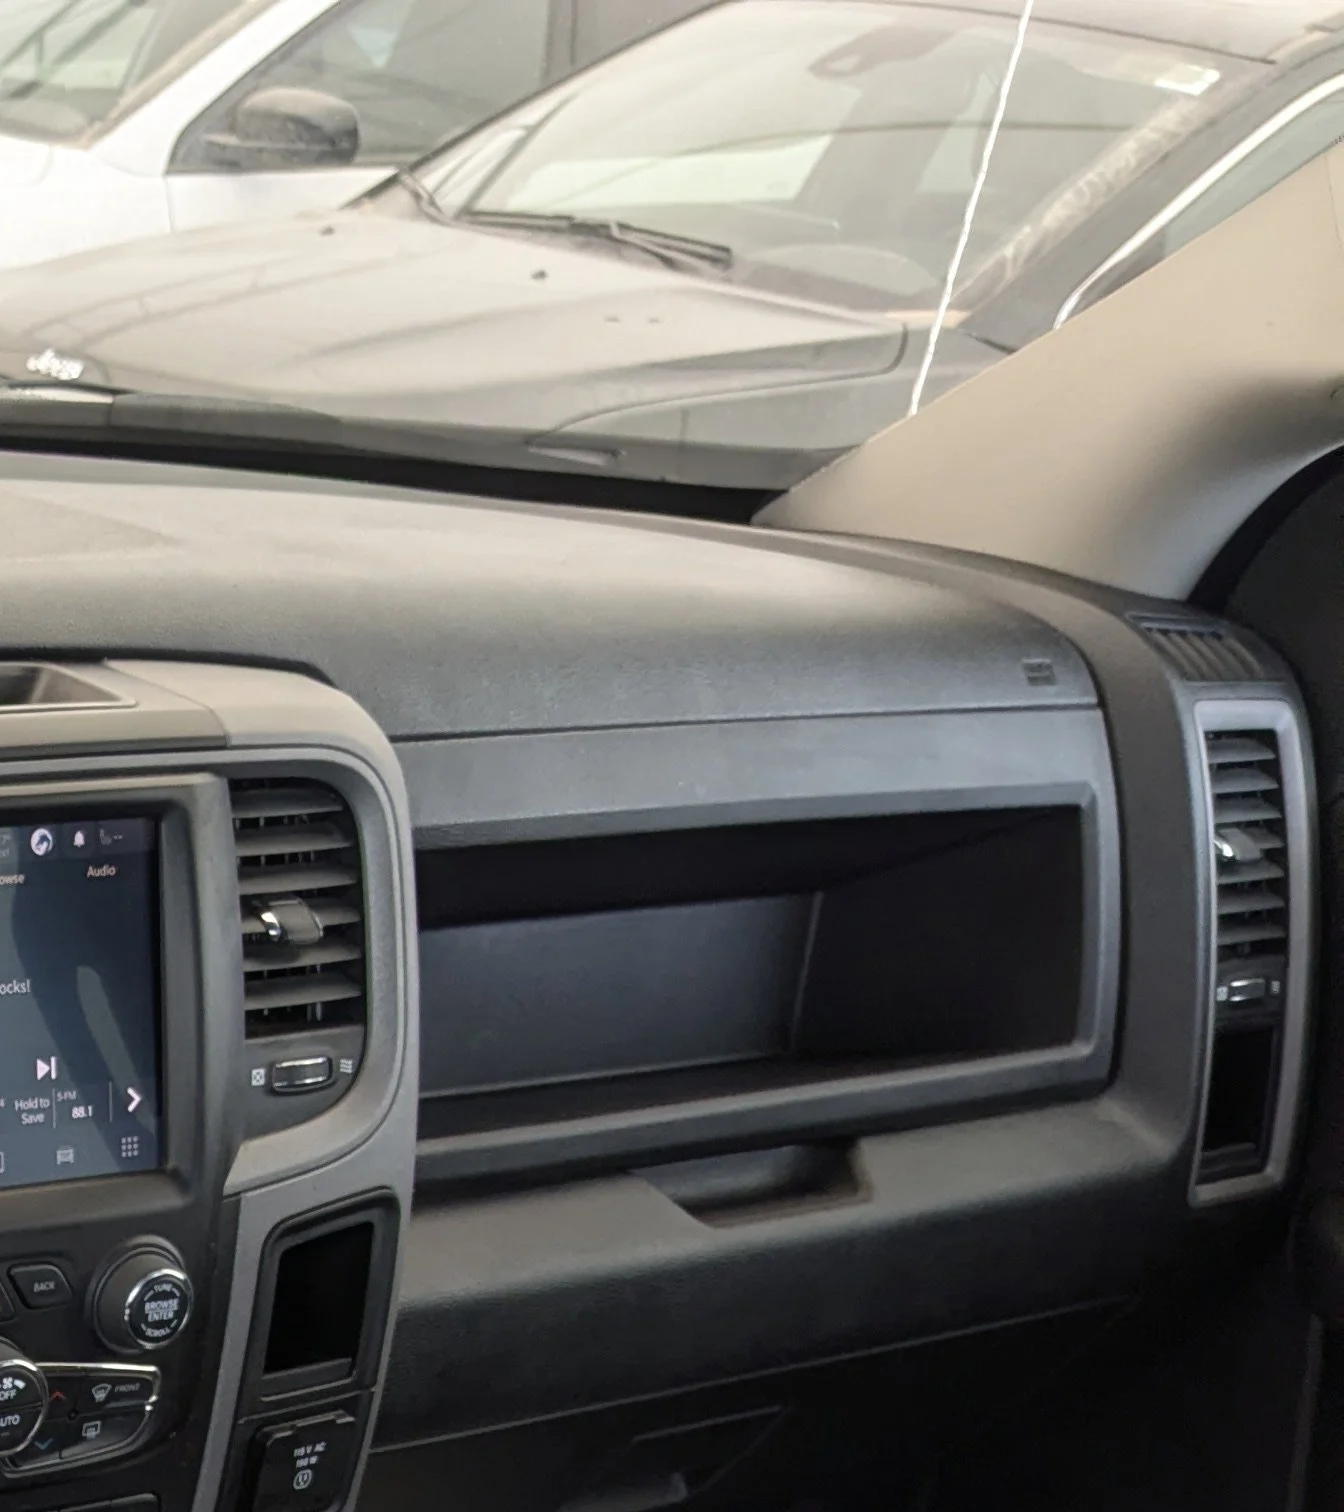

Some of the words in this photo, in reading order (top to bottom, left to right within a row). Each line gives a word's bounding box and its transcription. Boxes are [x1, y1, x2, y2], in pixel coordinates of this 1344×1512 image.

[86, 864, 116, 878] Audio
[14, 1098, 39, 1111] Hold
[40, 1097, 50, 1108] to
[21, 1112, 45, 1125] Save
[33, 1280, 56, 1293] BACK
